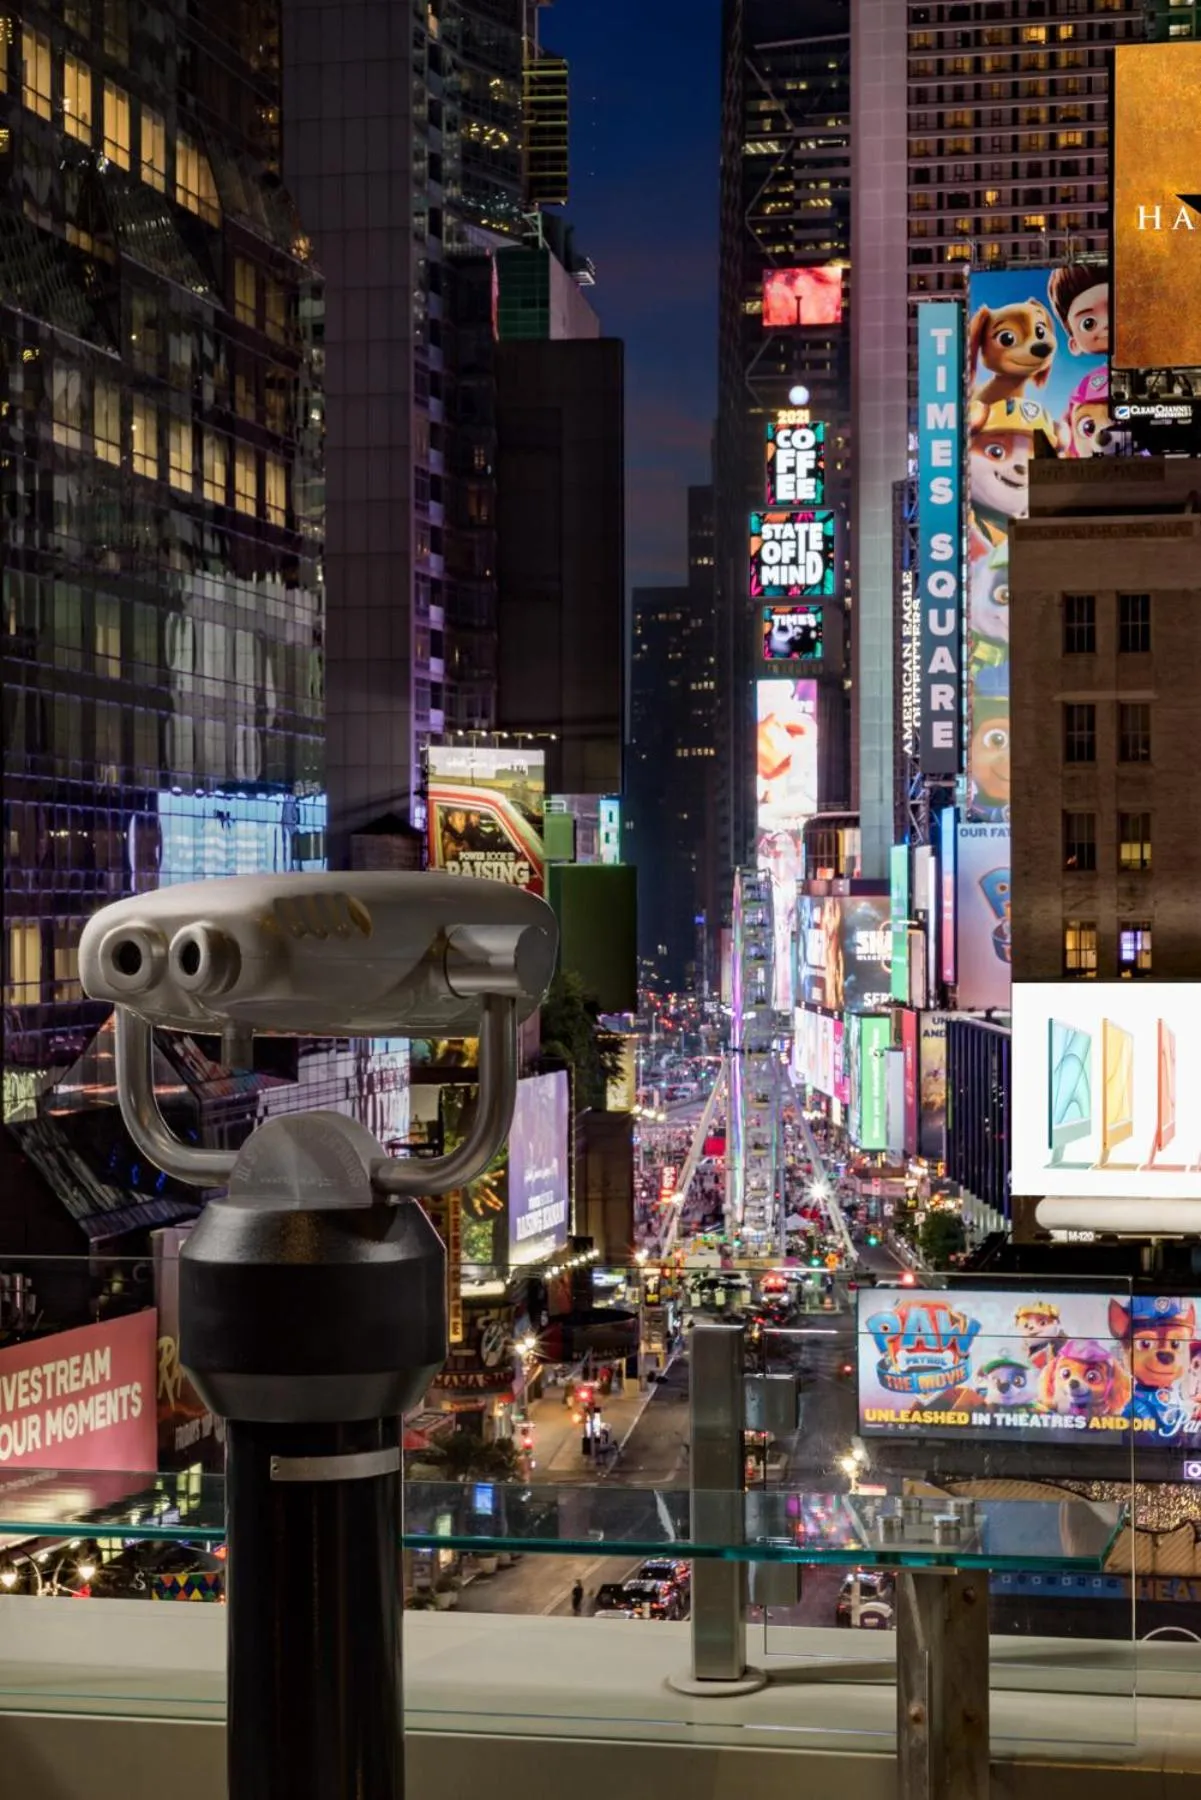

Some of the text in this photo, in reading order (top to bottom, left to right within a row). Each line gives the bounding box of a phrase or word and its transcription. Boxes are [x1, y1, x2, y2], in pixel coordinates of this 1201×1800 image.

[761, 522, 824, 563] STATE
[761, 540, 796, 565] OF
[927, 328, 957, 748] TIMES SQUARE
[761, 551, 824, 586] MIND
[902, 570, 913, 756] AMERICAN EAGLE
[960, 827, 988, 838] OUR
[865, 1306, 983, 1355] PAW
[884, 1369, 965, 1391] THE MOVIE
[45, 1382, 142, 1446] MOMENTS
[864, 1408, 970, 1426] UNLEASHED
[972, 1412, 991, 1426] IN
[993, 1413, 1087, 1430] THEATRES
[1089, 1416, 1130, 1431] AND
[1133, 1417, 1156, 1431] ON
